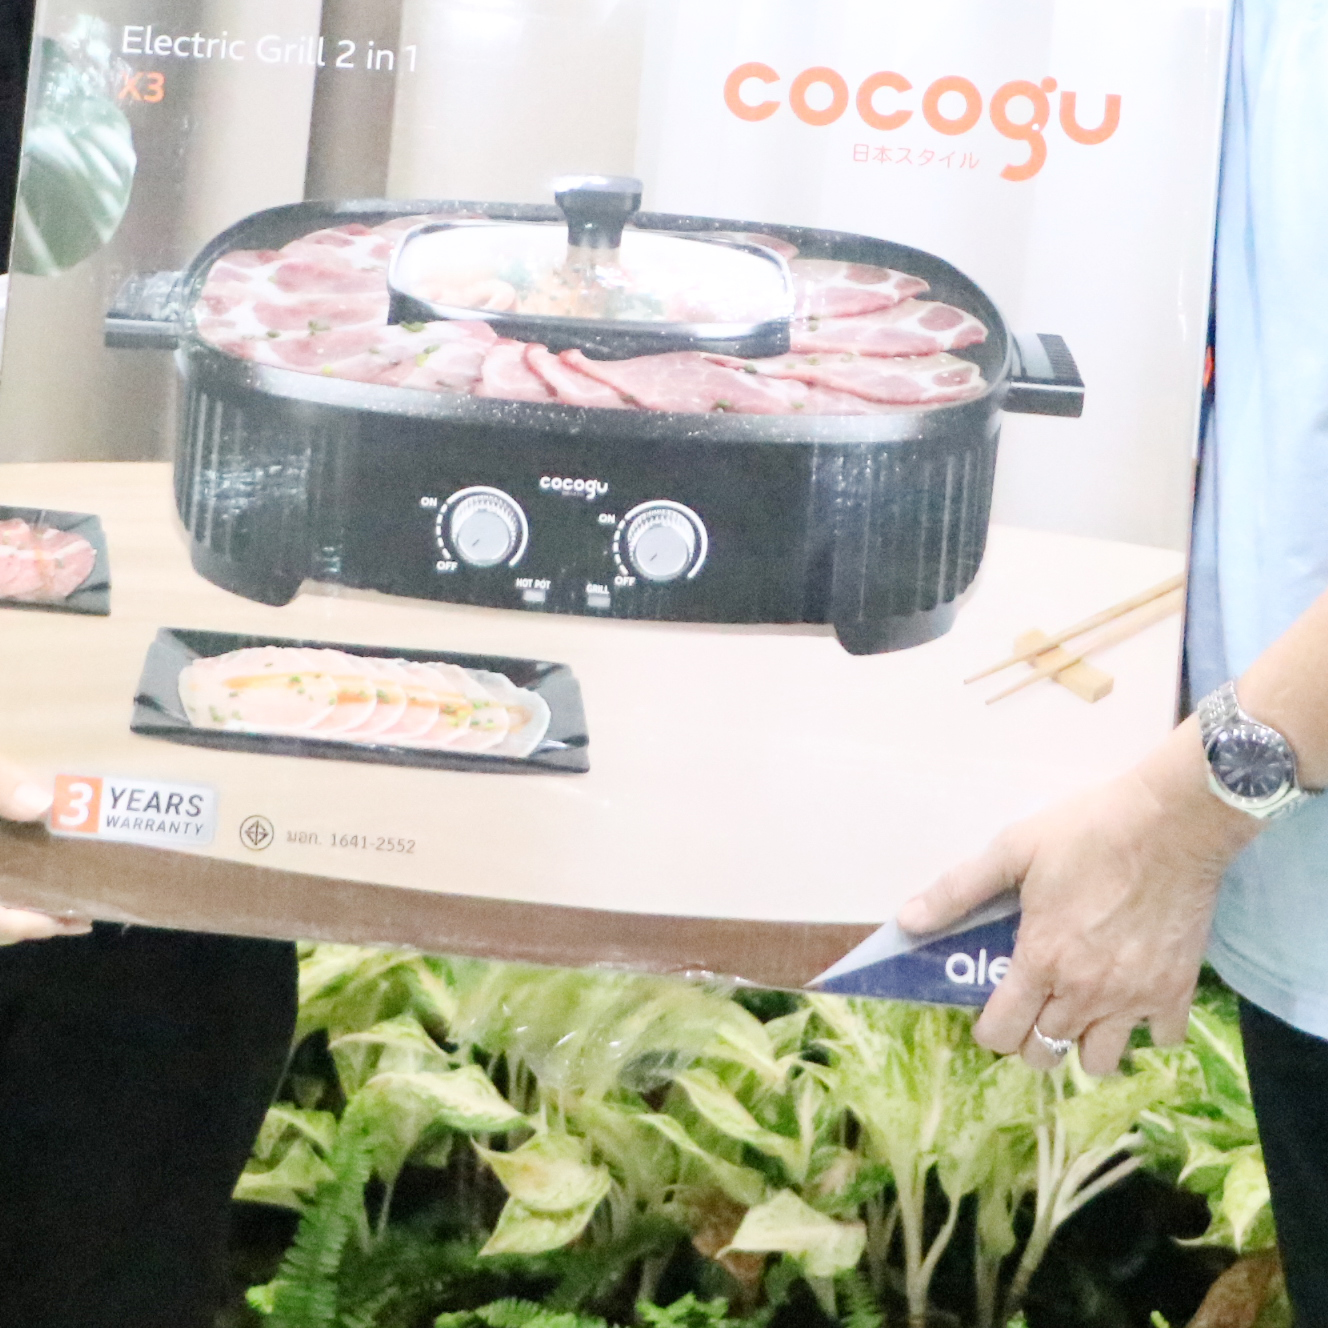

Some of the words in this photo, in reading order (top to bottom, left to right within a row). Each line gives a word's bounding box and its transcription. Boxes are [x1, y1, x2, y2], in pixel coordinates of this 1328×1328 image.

[121, 25, 245, 62] Electric
[255, 33, 326, 69] Grill
[335, 40, 356, 69] 2
[366, 41, 395, 71] in
[404, 45, 418, 72] 1
[117, 72, 165, 103] X3
[723, 61, 1122, 182] cocogu
[852, 143, 980, 171] 日本スタイル
[539, 475, 609, 500] cocogu
[421, 497, 438, 508] ON
[598, 513, 616, 524] ON
[436, 561, 458, 572] OFF
[515, 577, 532, 589] HOT
[533, 579, 551, 591] POT
[586, 583, 610, 596] GRILL
[614, 576, 636, 587] OFF
[59, 781, 94, 827] 3
[110, 786, 204, 818] YEARS
[105, 815, 204, 837] WARRANTY
[286, 829, 322, 846] มอก.
[330, 831, 416, 855] 1641-2552
[944, 948, 1014, 986] ale
